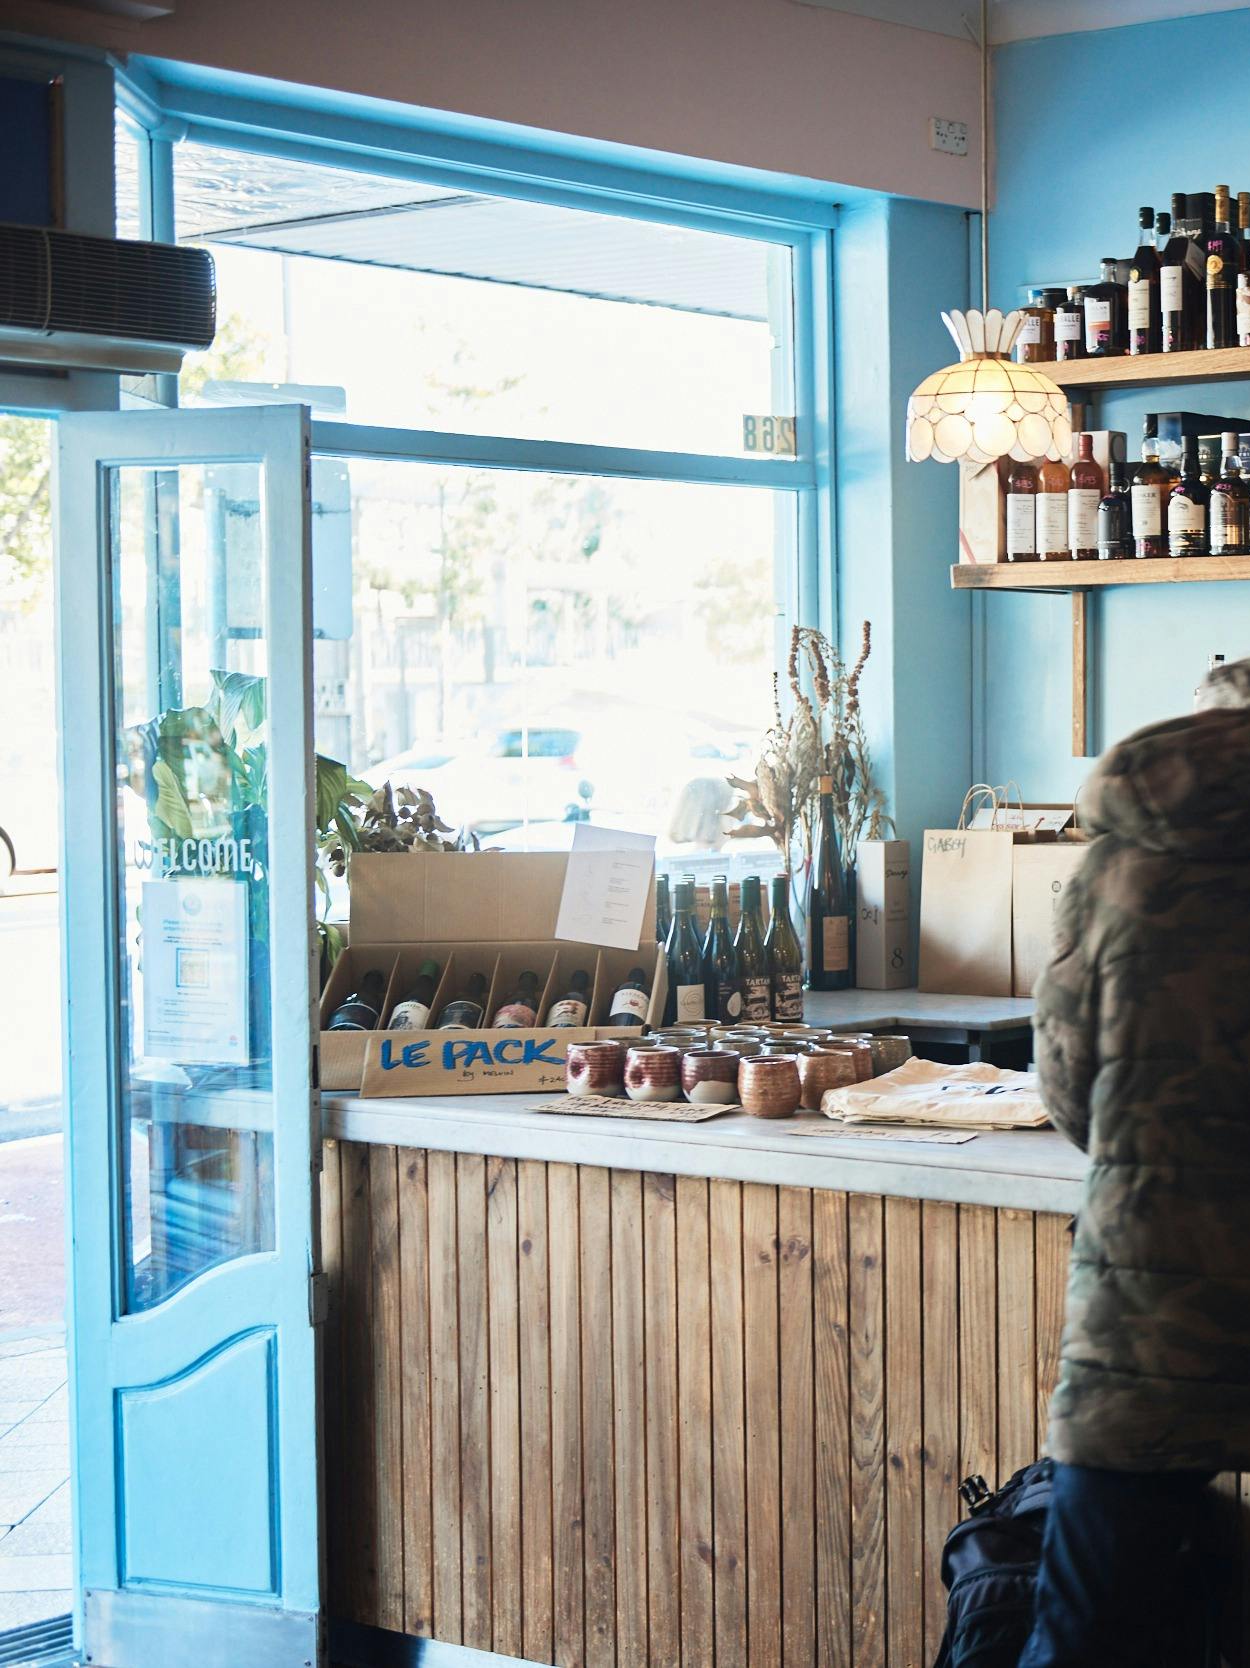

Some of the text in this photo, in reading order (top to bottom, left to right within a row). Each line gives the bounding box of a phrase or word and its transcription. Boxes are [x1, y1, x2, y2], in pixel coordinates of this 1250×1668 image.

[134, 837, 252, 870] WELCOME
[380, 1038, 567, 1072] LE PACK
